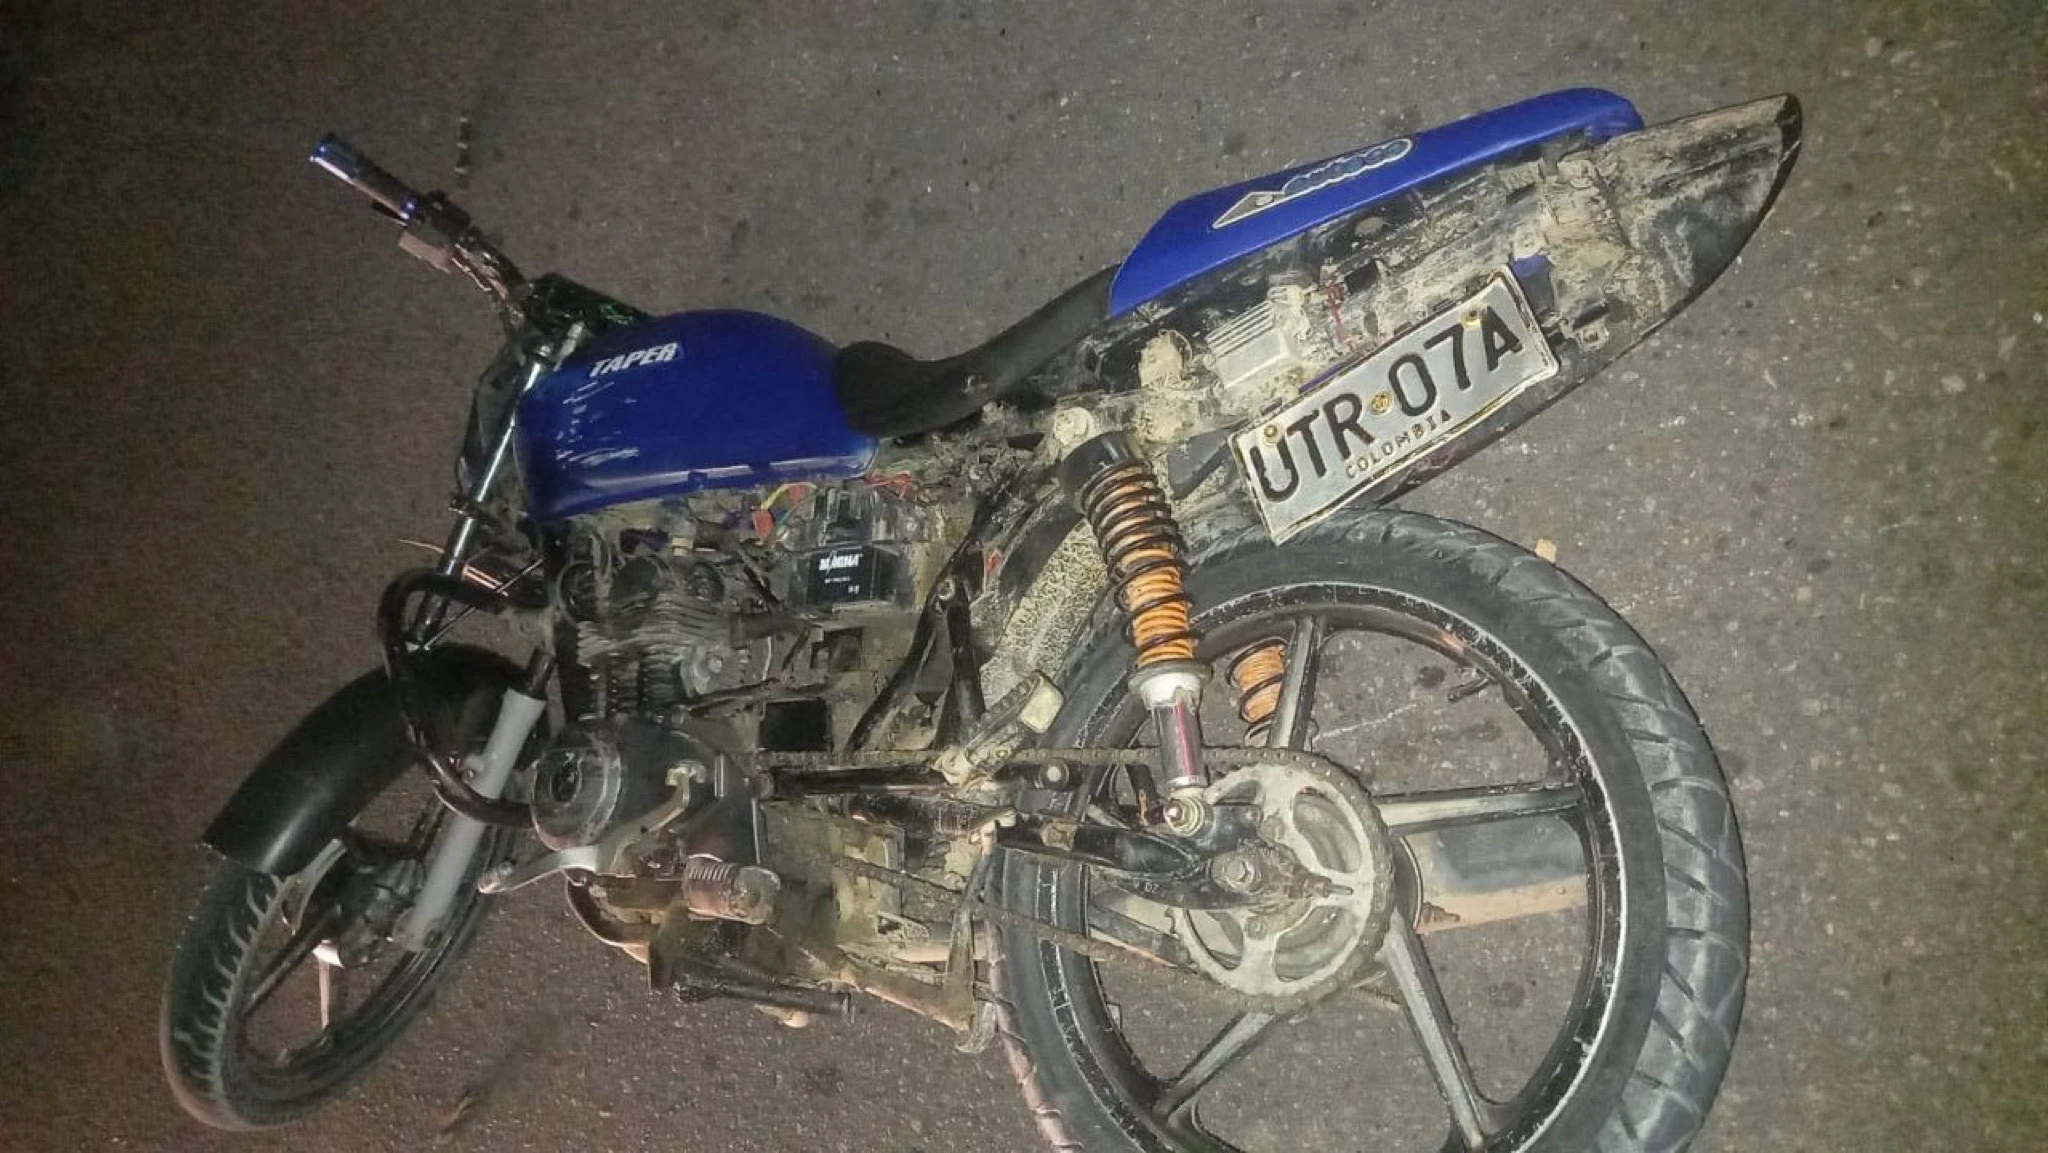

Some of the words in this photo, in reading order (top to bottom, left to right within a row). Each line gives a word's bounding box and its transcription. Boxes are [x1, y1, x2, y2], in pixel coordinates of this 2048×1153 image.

[588, 342, 679, 379] TAPER
[1249, 392, 1375, 502] UTR
[1387, 305, 1523, 418] 07A
[1344, 408, 1453, 480] COLOMBIA
